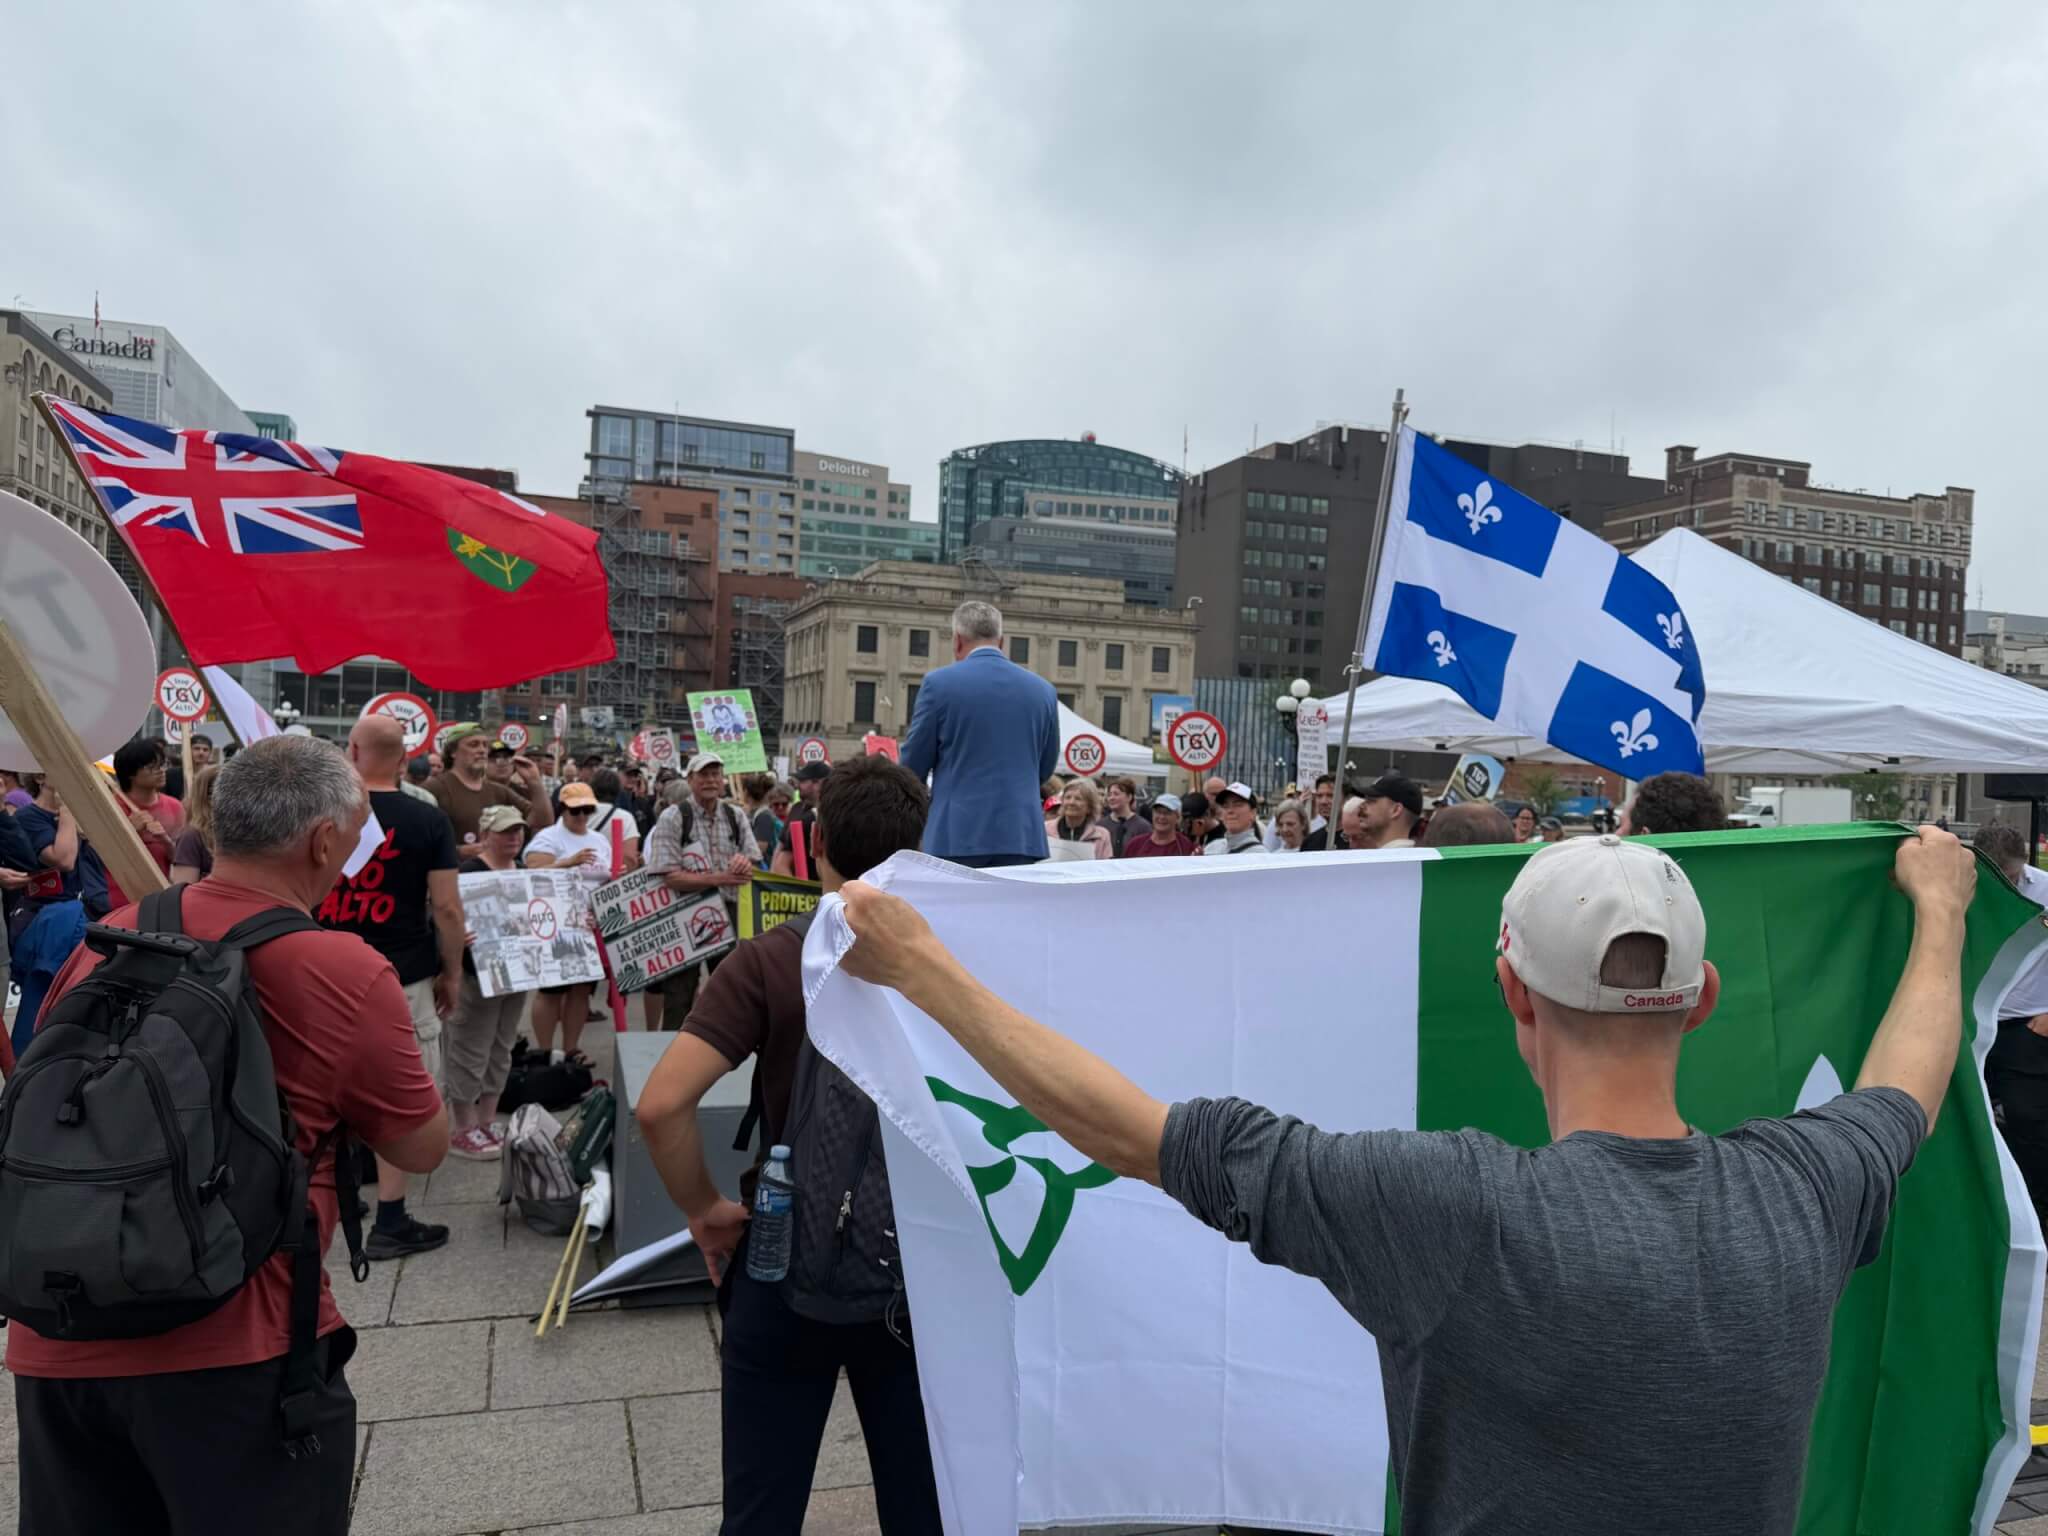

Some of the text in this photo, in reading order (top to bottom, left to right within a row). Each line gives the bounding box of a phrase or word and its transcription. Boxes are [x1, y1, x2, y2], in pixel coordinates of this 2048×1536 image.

[52, 323, 153, 361] Canada
[818, 459, 870, 477] Deloitte
[163, 686, 202, 703] TGV
[1175, 732, 1217, 750] TGV
[1071, 748, 1101, 761] TGV
[1187, 752, 1207, 760] ALTO
[1471, 765, 1488, 785] TGV
[594, 870, 653, 906] FOOD SECU
[318, 889, 396, 923] ALTO
[629, 885, 671, 921] ALTO
[531, 911, 554, 924] ALTO
[615, 916, 677, 953] LA SÉCURITÉ
[620, 928, 682, 963] ALIMENTAIRE
[646, 945, 685, 976] ALTO
[1623, 992, 1684, 1008] Canada
